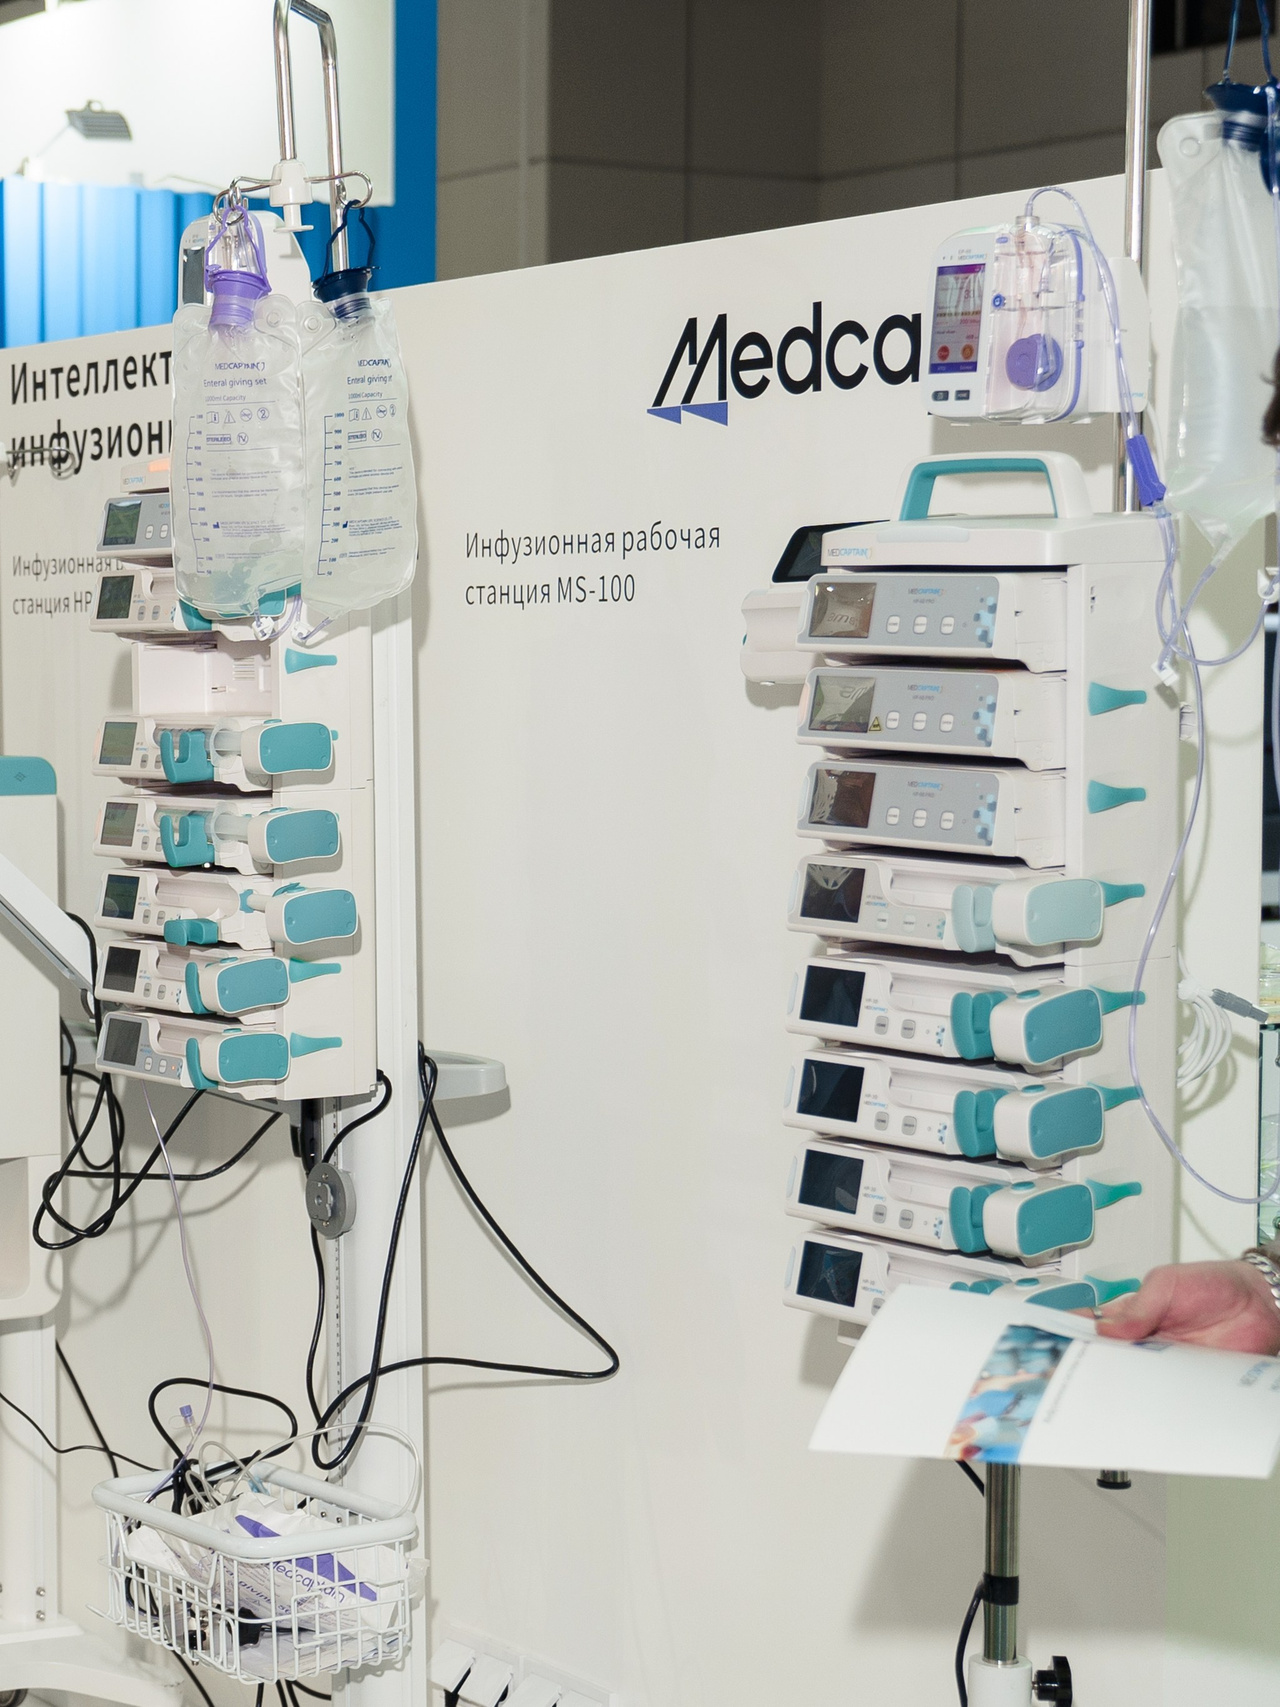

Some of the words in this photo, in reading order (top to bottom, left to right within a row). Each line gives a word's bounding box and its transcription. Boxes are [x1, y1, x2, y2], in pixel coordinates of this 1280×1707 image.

[652, 301, 922, 407] Medca
[11, 350, 172, 405] Интеллект
[203, 378, 227, 388] Enteral
[228, 378, 253, 388] giving
[367, 375, 388, 385] giving
[11, 419, 172, 476] инфузион
[466, 529, 614, 565] Инфузионная
[622, 520, 720, 560] рабочая
[827, 548, 869, 558] MEDCAPTAIN
[12, 552, 112, 582] Инфузионная
[12, 597, 69, 619] станция
[465, 584, 551, 611] станция
[557, 573, 636, 603] MS-100
